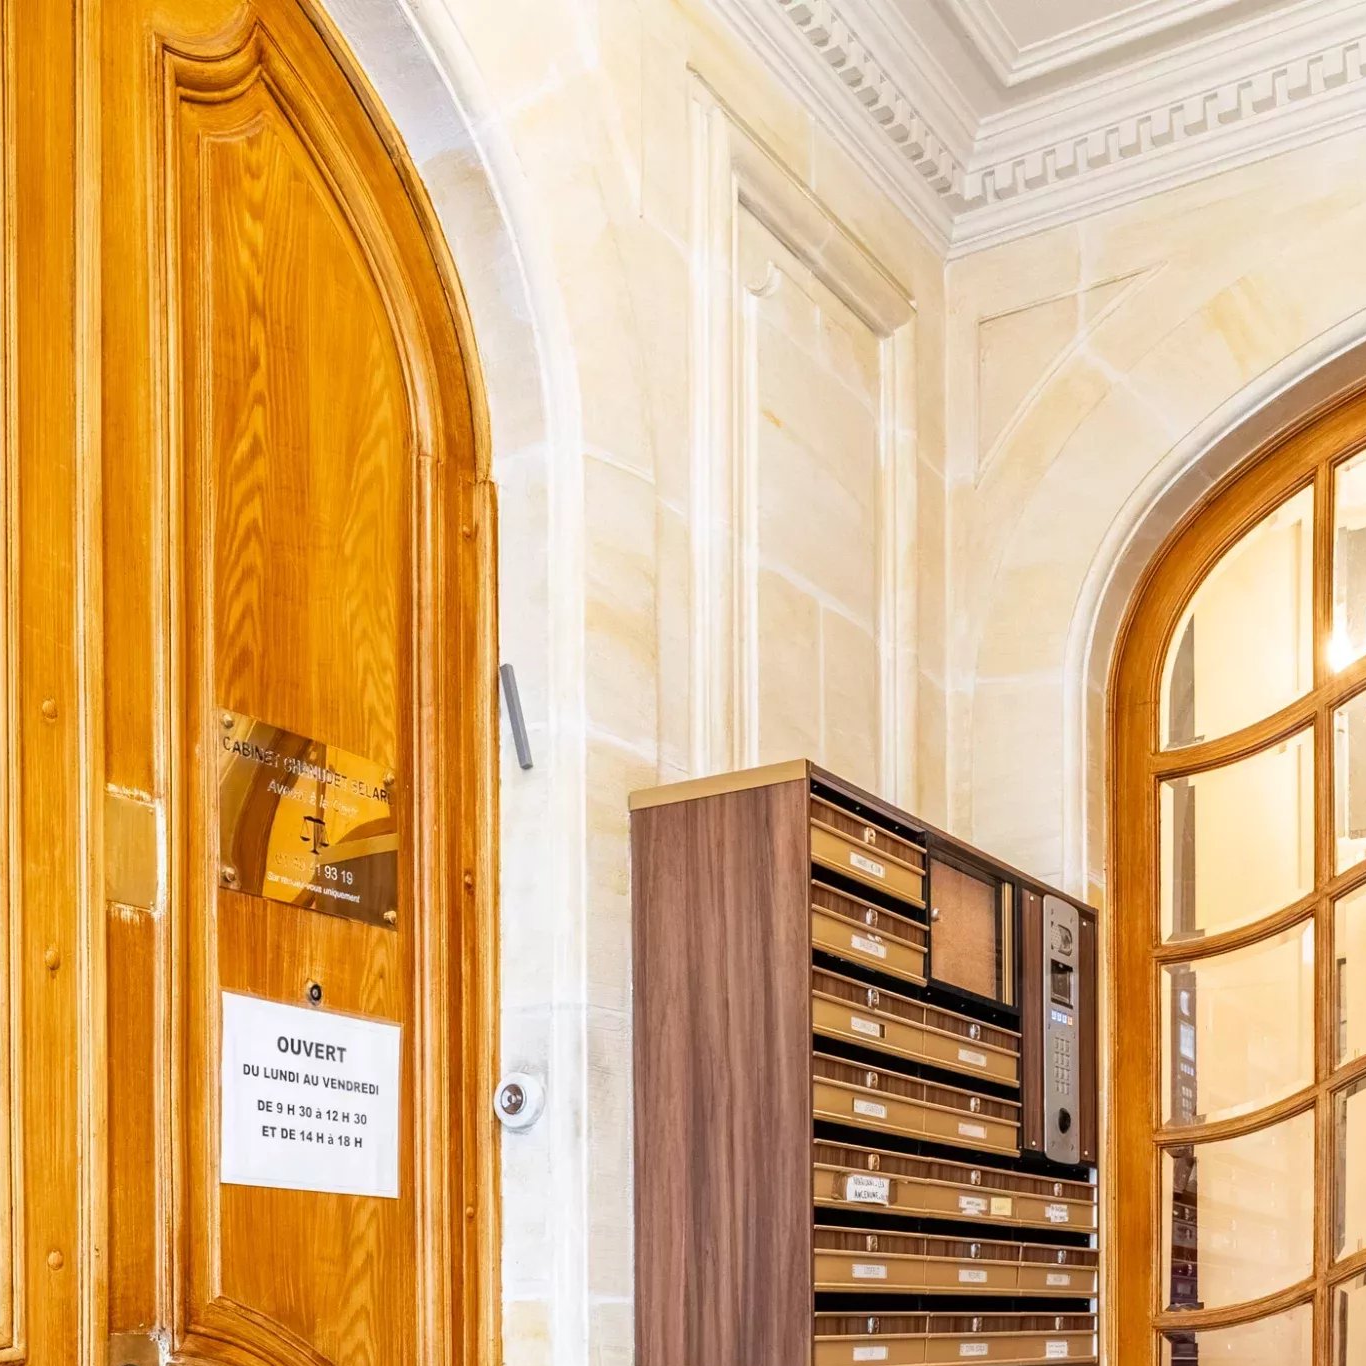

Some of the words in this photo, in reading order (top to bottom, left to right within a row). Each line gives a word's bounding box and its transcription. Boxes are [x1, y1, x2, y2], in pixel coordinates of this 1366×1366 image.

[223, 736, 281, 768] CABINET
[324, 865, 339, 881] 93
[340, 870, 353, 885] 19
[323, 888, 360, 903] uniquement
[277, 1035, 347, 1063] OUVERT
[243, 1063, 259, 1077] DU
[263, 1066, 299, 1084] LUNDI
[303, 1074, 319, 1087] AU
[323, 1077, 379, 1096] VENDREDI
[257, 1099, 273, 1113] DE
[276, 1102, 283, 1114] 9
[287, 1104, 295, 1115] H
[299, 1106, 312, 1118] 30
[315, 1108, 322, 1119] à
[326, 1109, 338, 1122] 12
[341, 1112, 350, 1123] H
[354, 1113, 367, 1125] 30
[262, 1125, 276, 1139] ET
[281, 1127, 296, 1140] DE
[300, 1130, 313, 1142] 14
[316, 1132, 324, 1144] H
[327, 1133, 334, 1145] à
[337, 1135, 350, 1147] 18
[354, 1137, 363, 1148] H
